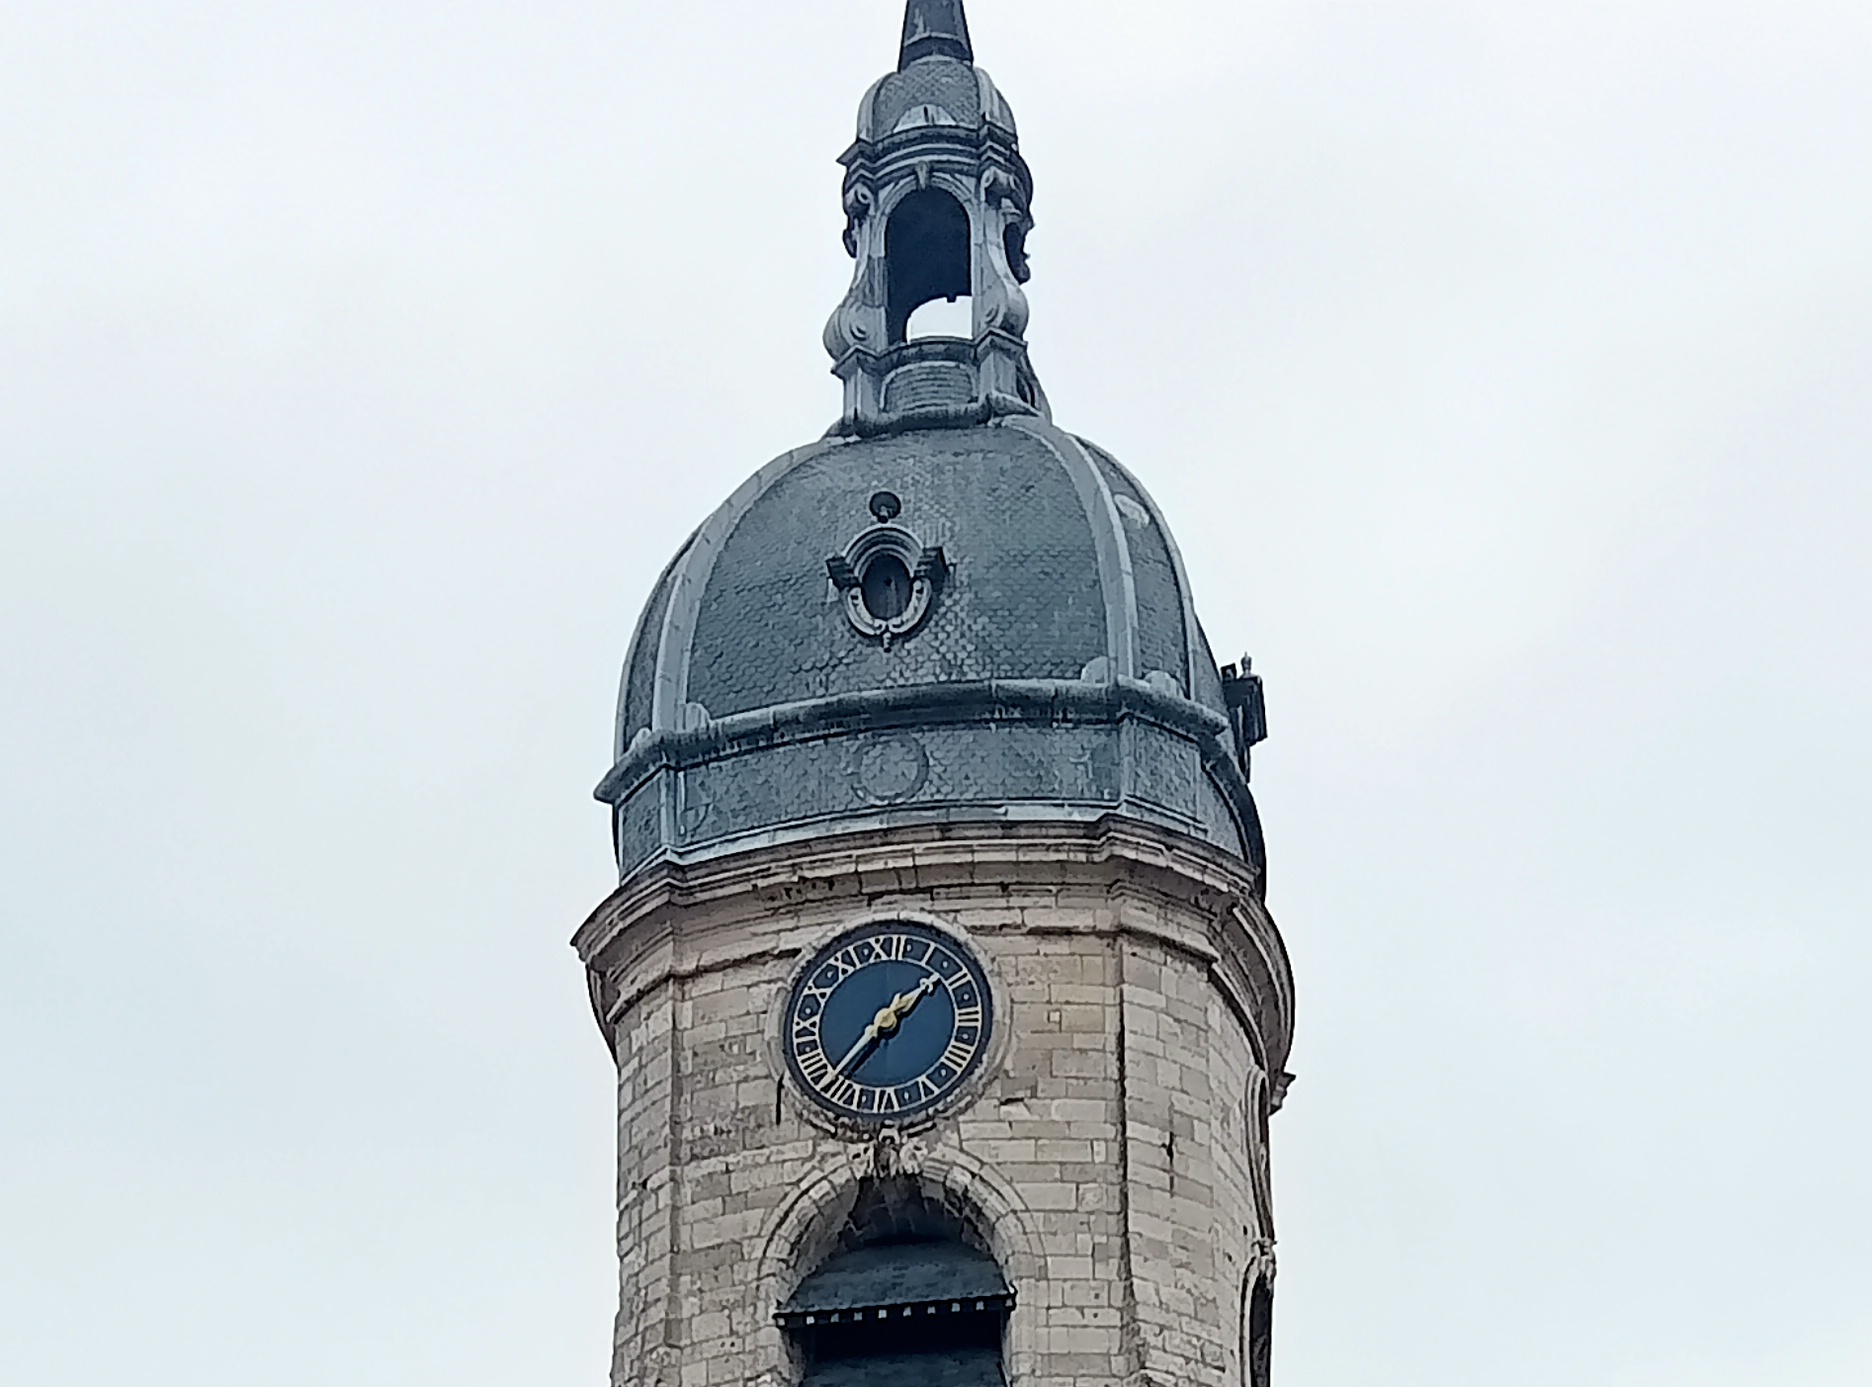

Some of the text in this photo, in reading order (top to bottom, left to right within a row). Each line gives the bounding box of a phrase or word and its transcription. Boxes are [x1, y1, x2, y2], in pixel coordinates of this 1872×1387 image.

[868, 936, 906, 961] XII
[921, 942, 936, 965] I
[826, 948, 861, 980] XI
[945, 967, 973, 991] II
[803, 980, 833, 1008] X
[793, 1014, 819, 1044] IX
[956, 1006, 980, 1027] III
[941, 1040, 975, 1072] IIII
[872, 1088, 900, 1114] VI
